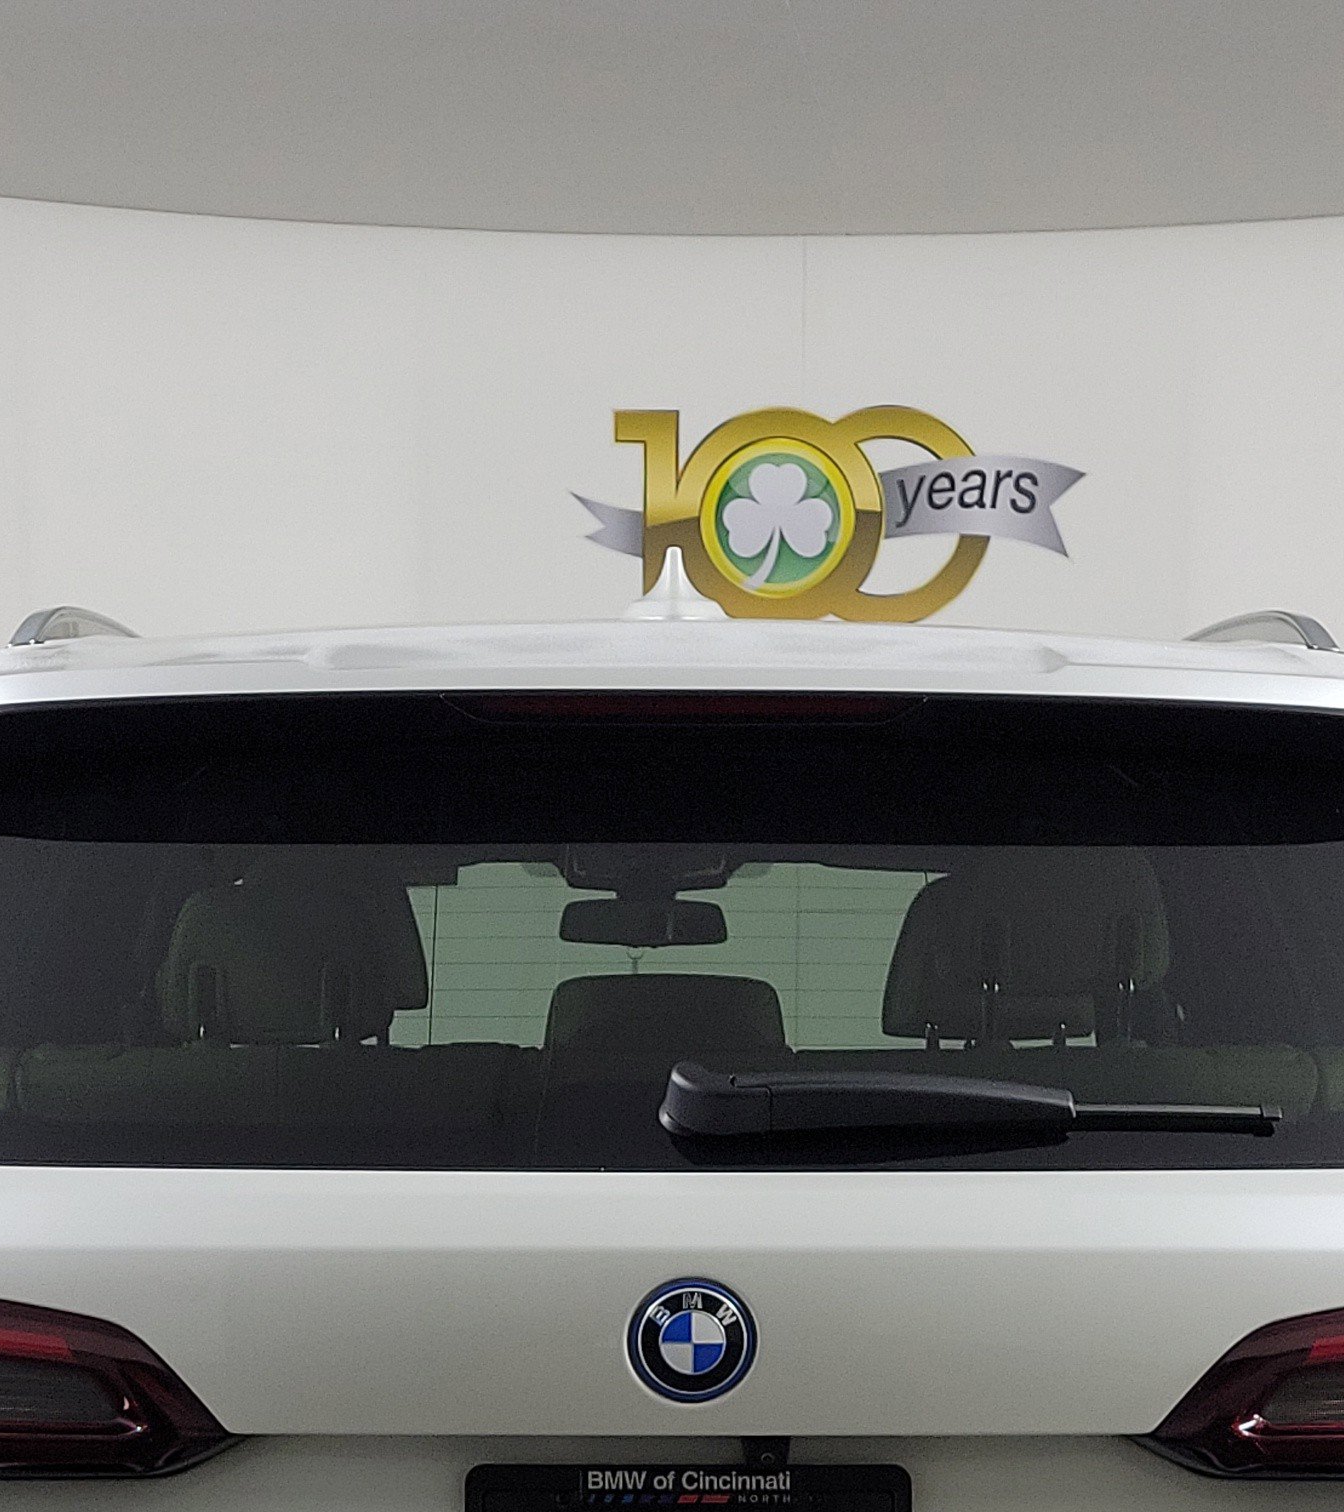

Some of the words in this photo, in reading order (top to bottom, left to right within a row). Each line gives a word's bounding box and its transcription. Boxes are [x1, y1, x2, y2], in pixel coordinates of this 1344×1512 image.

[895, 468, 1039, 528] years
[650, 1292, 737, 1326] BMW
[587, 1470, 647, 1490] BMW
[653, 1470, 675, 1490] of
[681, 1470, 791, 1490] Cincinnati
[737, 1494, 791, 1503] NORTH
